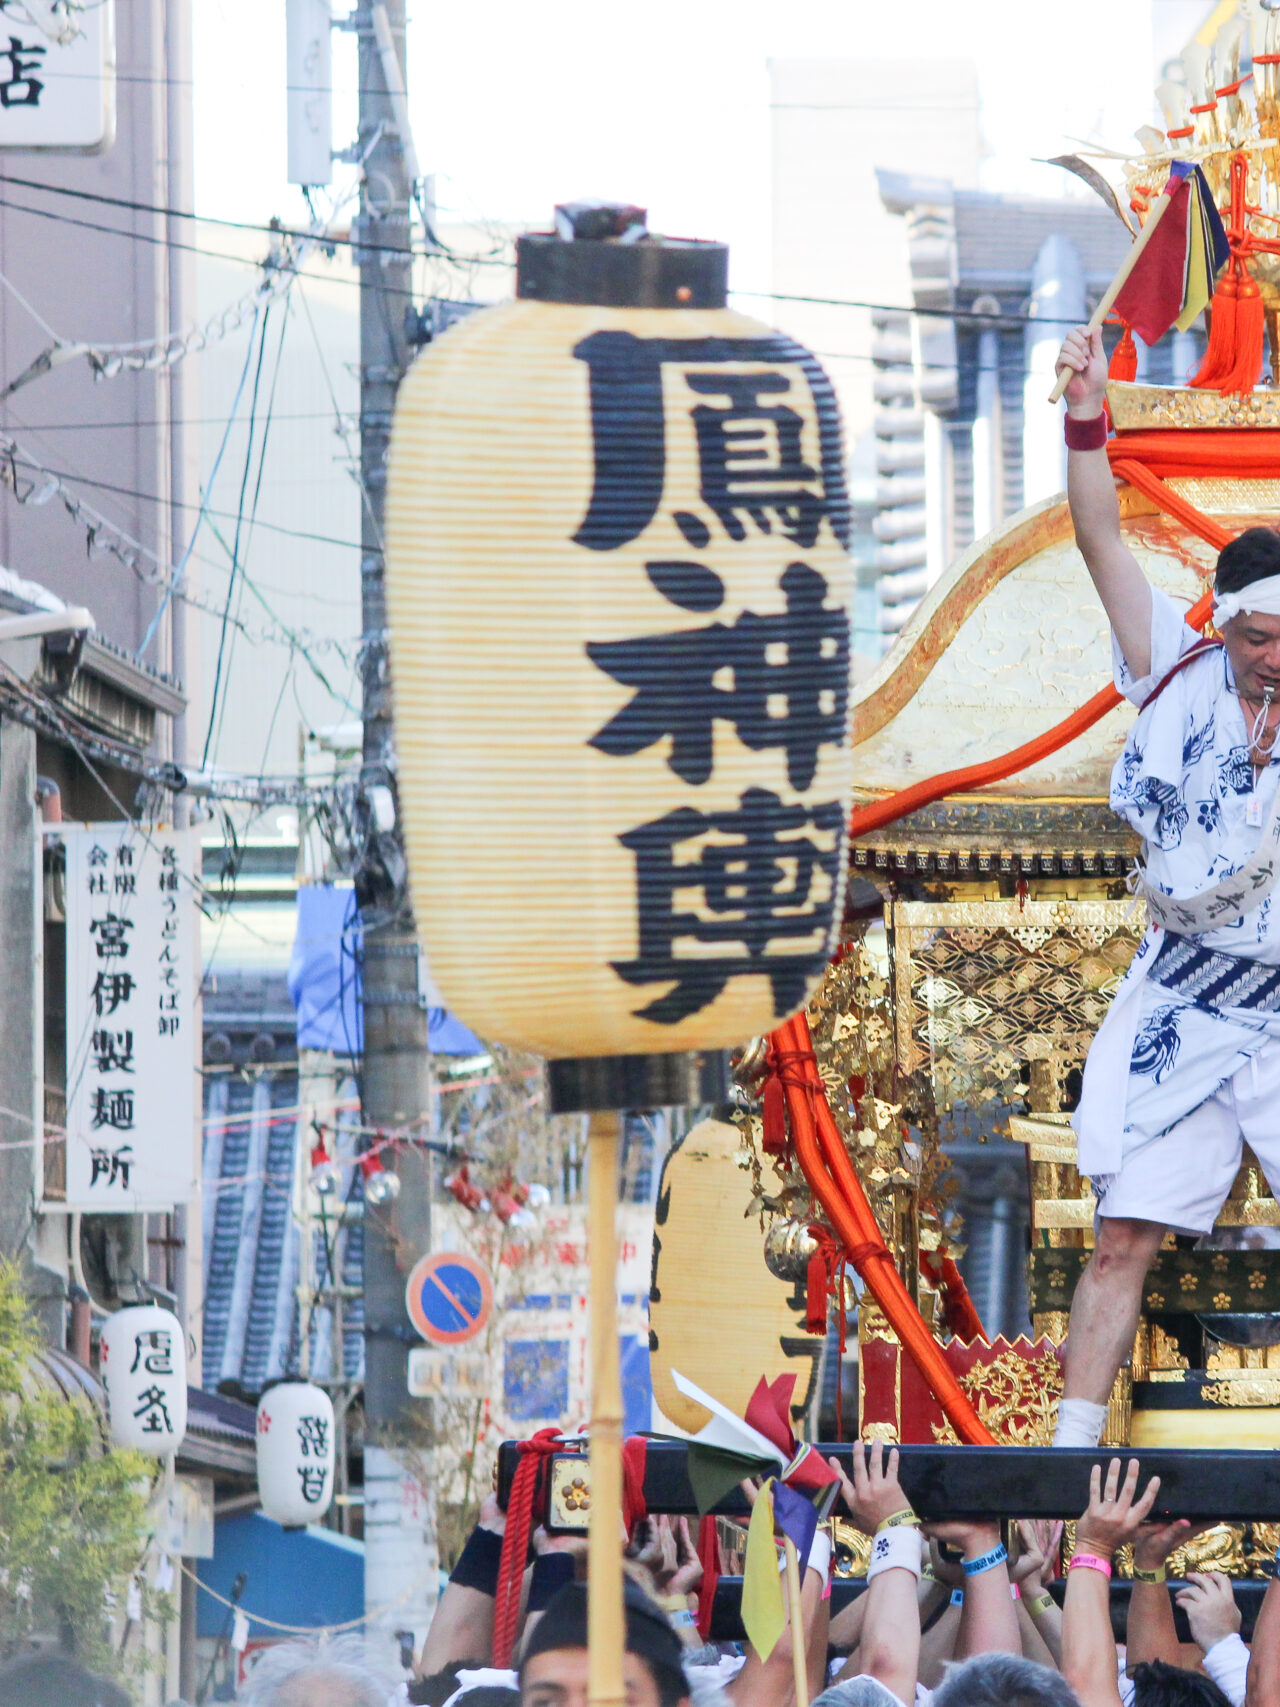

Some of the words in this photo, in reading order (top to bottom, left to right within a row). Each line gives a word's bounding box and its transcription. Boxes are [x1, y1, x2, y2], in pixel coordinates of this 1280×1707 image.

[571, 330, 850, 1024] 鳳神輿
[87, 844, 108, 895] 会社
[114, 844, 137, 895] 有限
[158, 845, 180, 1037] 各種うどんそば卸
[89, 912, 137, 1190] 宮伊製麺所
